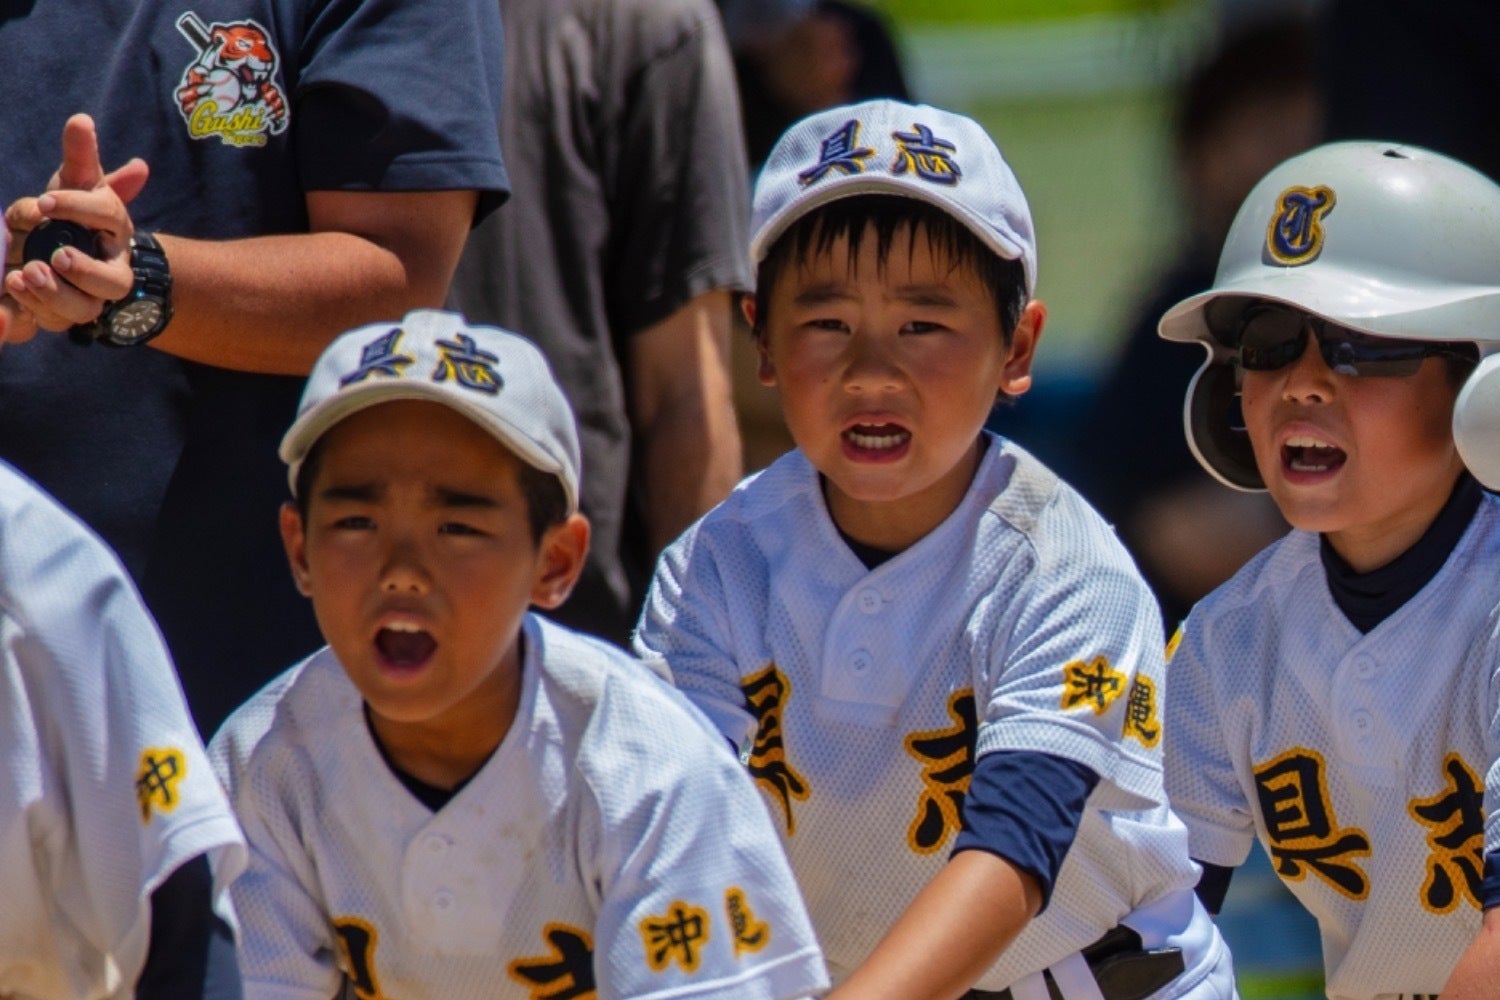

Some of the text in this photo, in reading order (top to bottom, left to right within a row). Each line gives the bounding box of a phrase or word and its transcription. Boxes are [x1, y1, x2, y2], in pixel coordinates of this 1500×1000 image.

[190, 101, 265, 136] Gushi
[798, 119, 963, 186] 具志
[338, 328, 504, 396] 具志
